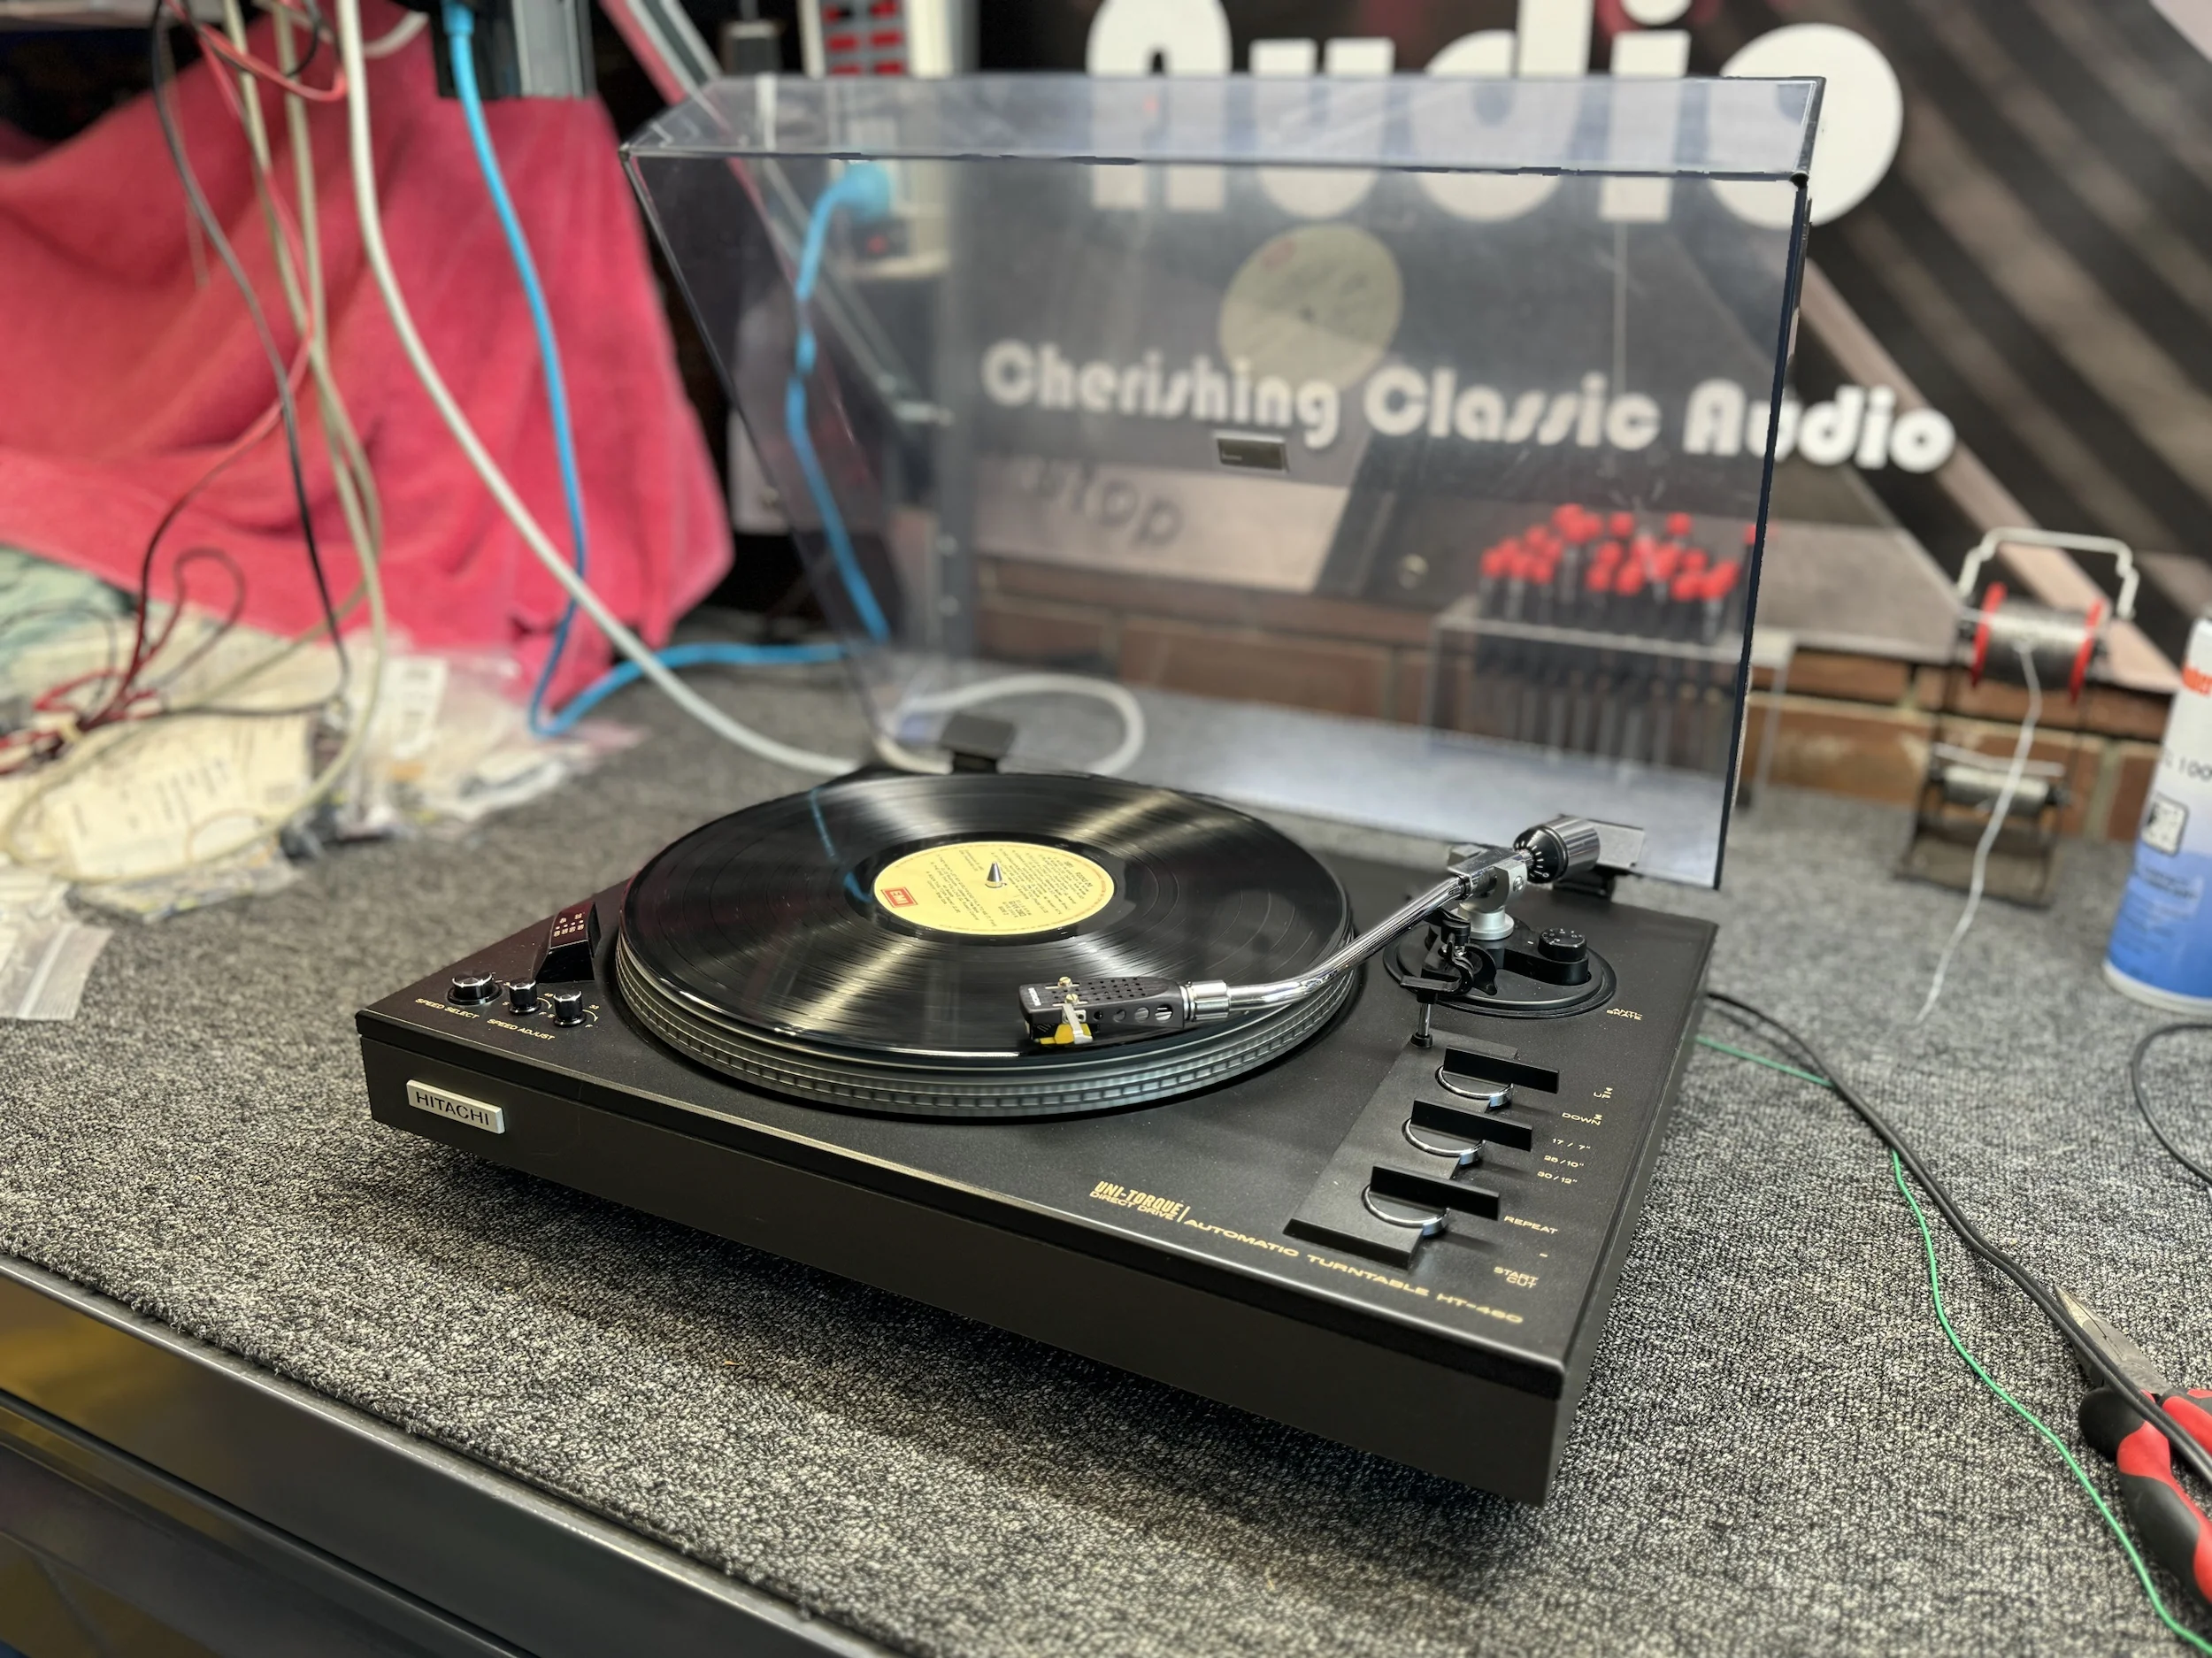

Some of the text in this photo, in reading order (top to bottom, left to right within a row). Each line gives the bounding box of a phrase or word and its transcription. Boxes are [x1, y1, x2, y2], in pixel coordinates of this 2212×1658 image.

[1087, 0, 1904, 226] Audio
[982, 339, 1955, 472] Cherishing Classic Audio
[415, 998, 480, 1019] SPEED SELECT
[487, 1018, 556, 1040] SPEED ADJUST
[416, 1091, 489, 1125] HITACHI
[1562, 1112, 1601, 1126] DOWN
[1089, 1190, 1178, 1221] DIRECT DRIVE
[1094, 1181, 1184, 1215] UNI-TORQUE
[1504, 1216, 1558, 1234] REPEAT
[1184, 1218, 1300, 1257] AUTOMATIC
[1307, 1254, 1430, 1297] TURNTABLE
[1494, 1266, 1539, 1283] START
